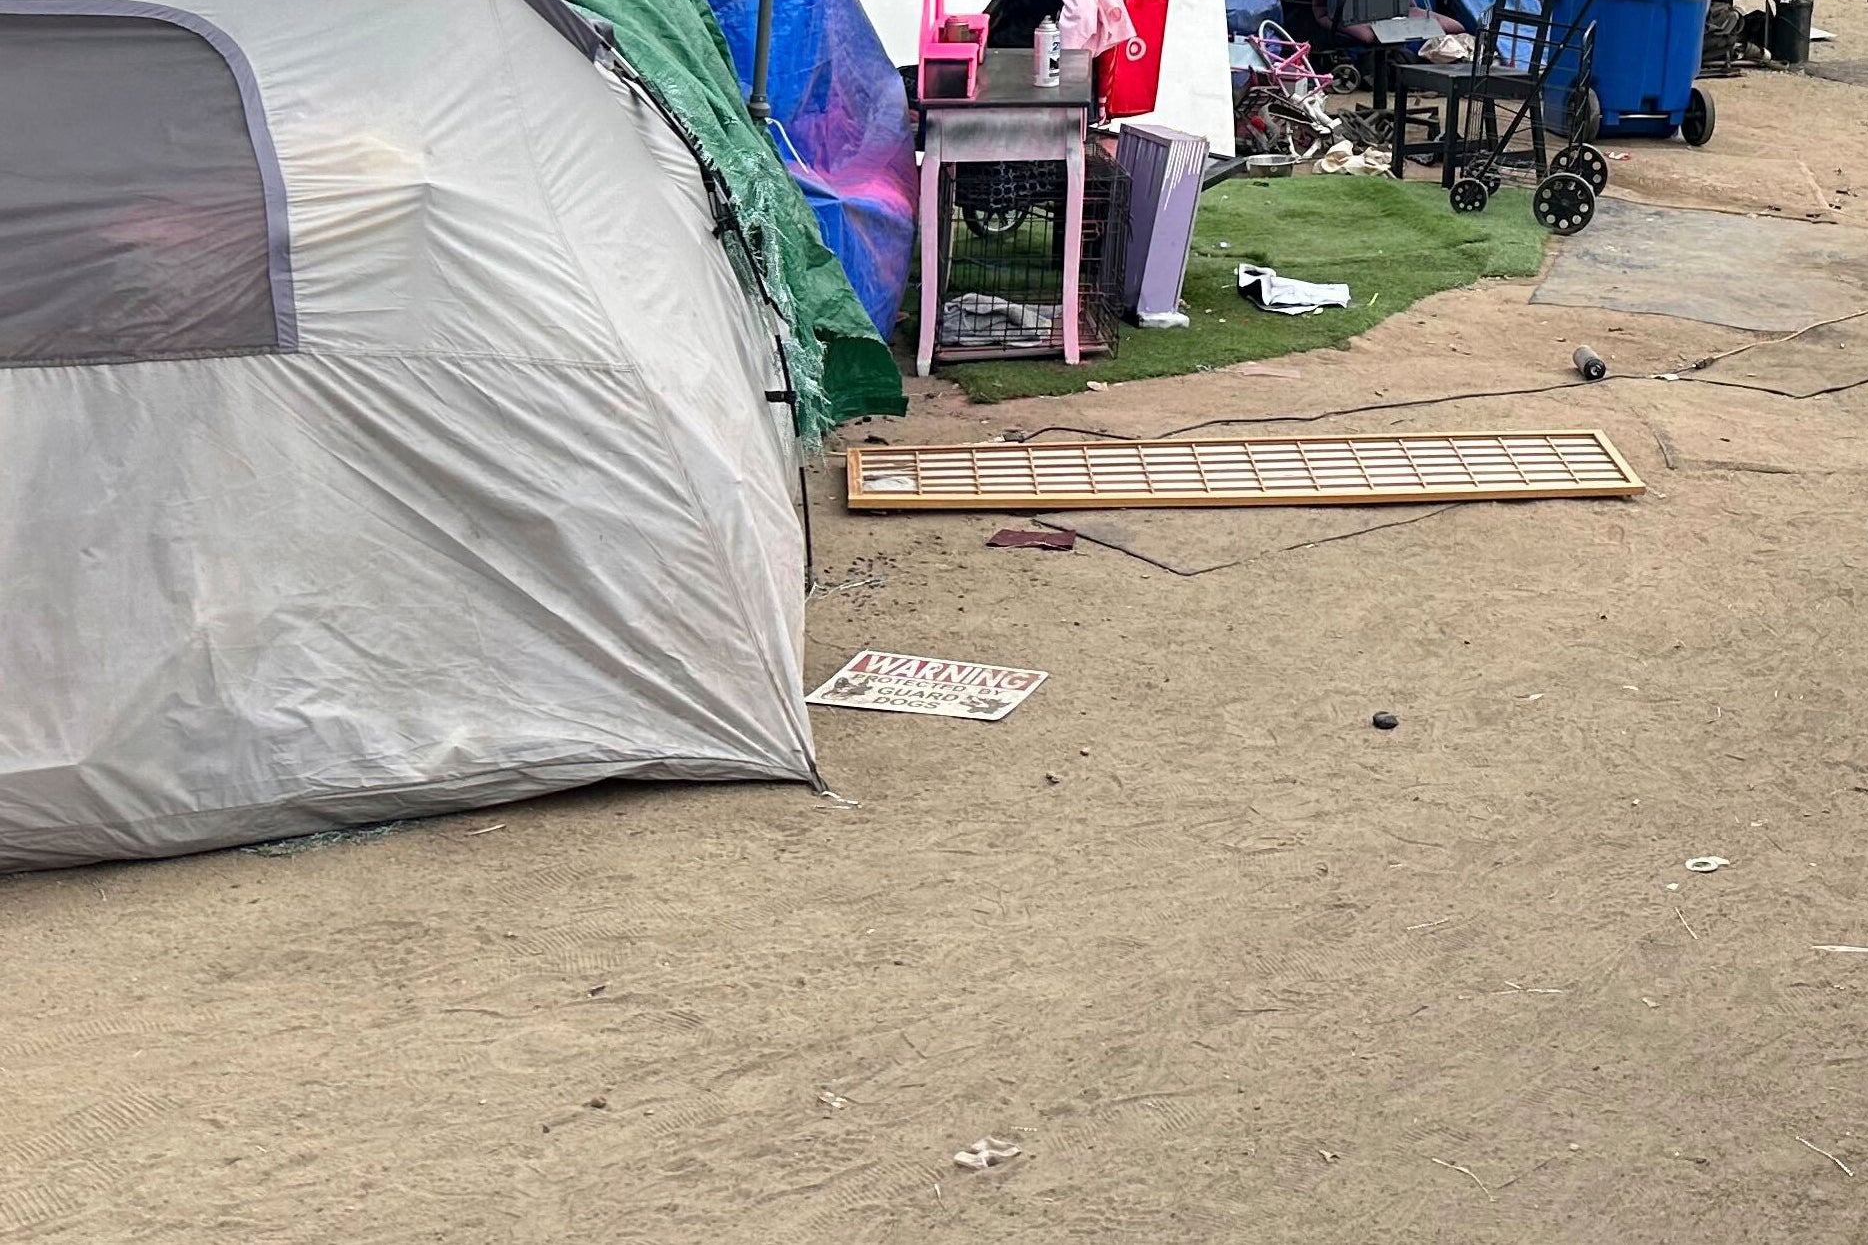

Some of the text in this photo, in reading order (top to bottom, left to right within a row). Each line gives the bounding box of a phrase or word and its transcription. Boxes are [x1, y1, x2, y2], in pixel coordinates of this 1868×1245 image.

[865, 655, 1032, 689] WARNING
[852, 673, 1003, 697] PROTECTED BY
[877, 686, 960, 702] GUARD
[872, 696, 941, 710] DOGS
